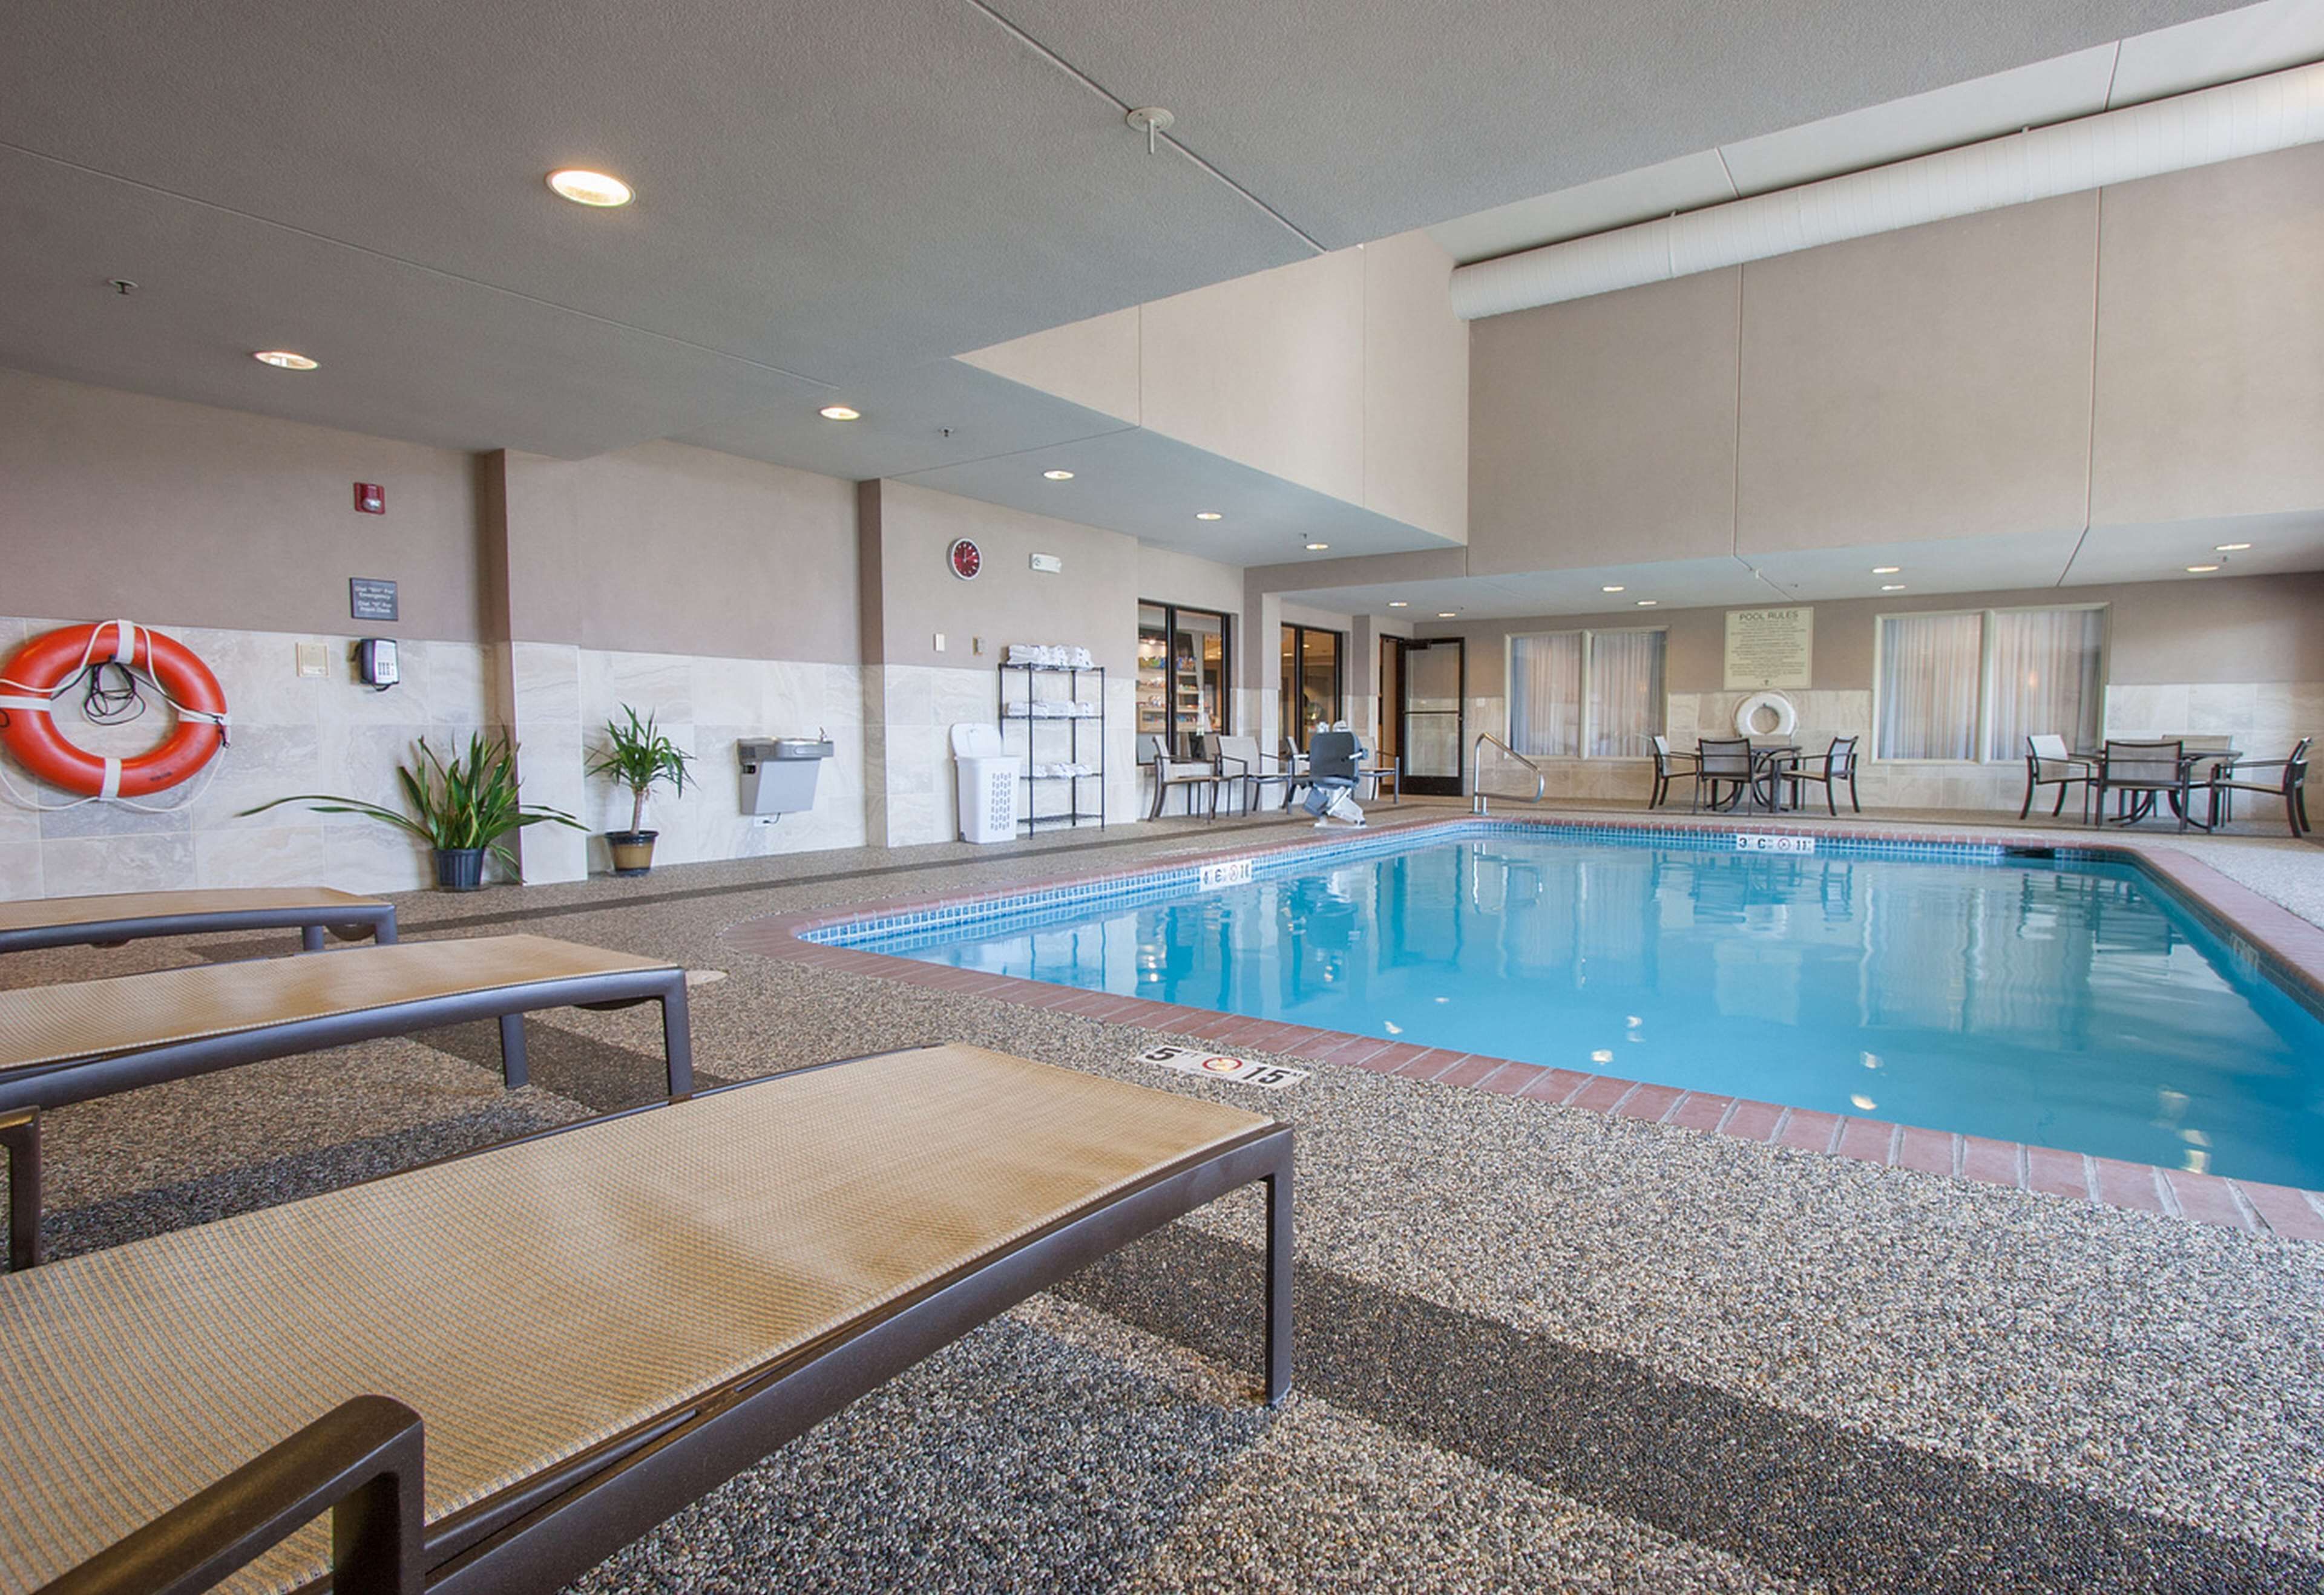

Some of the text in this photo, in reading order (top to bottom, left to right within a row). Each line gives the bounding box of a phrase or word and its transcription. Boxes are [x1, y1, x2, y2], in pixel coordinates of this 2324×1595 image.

[1739, 610, 1799, 621] POOL RULES
[1145, 1047, 1183, 1061] 5
